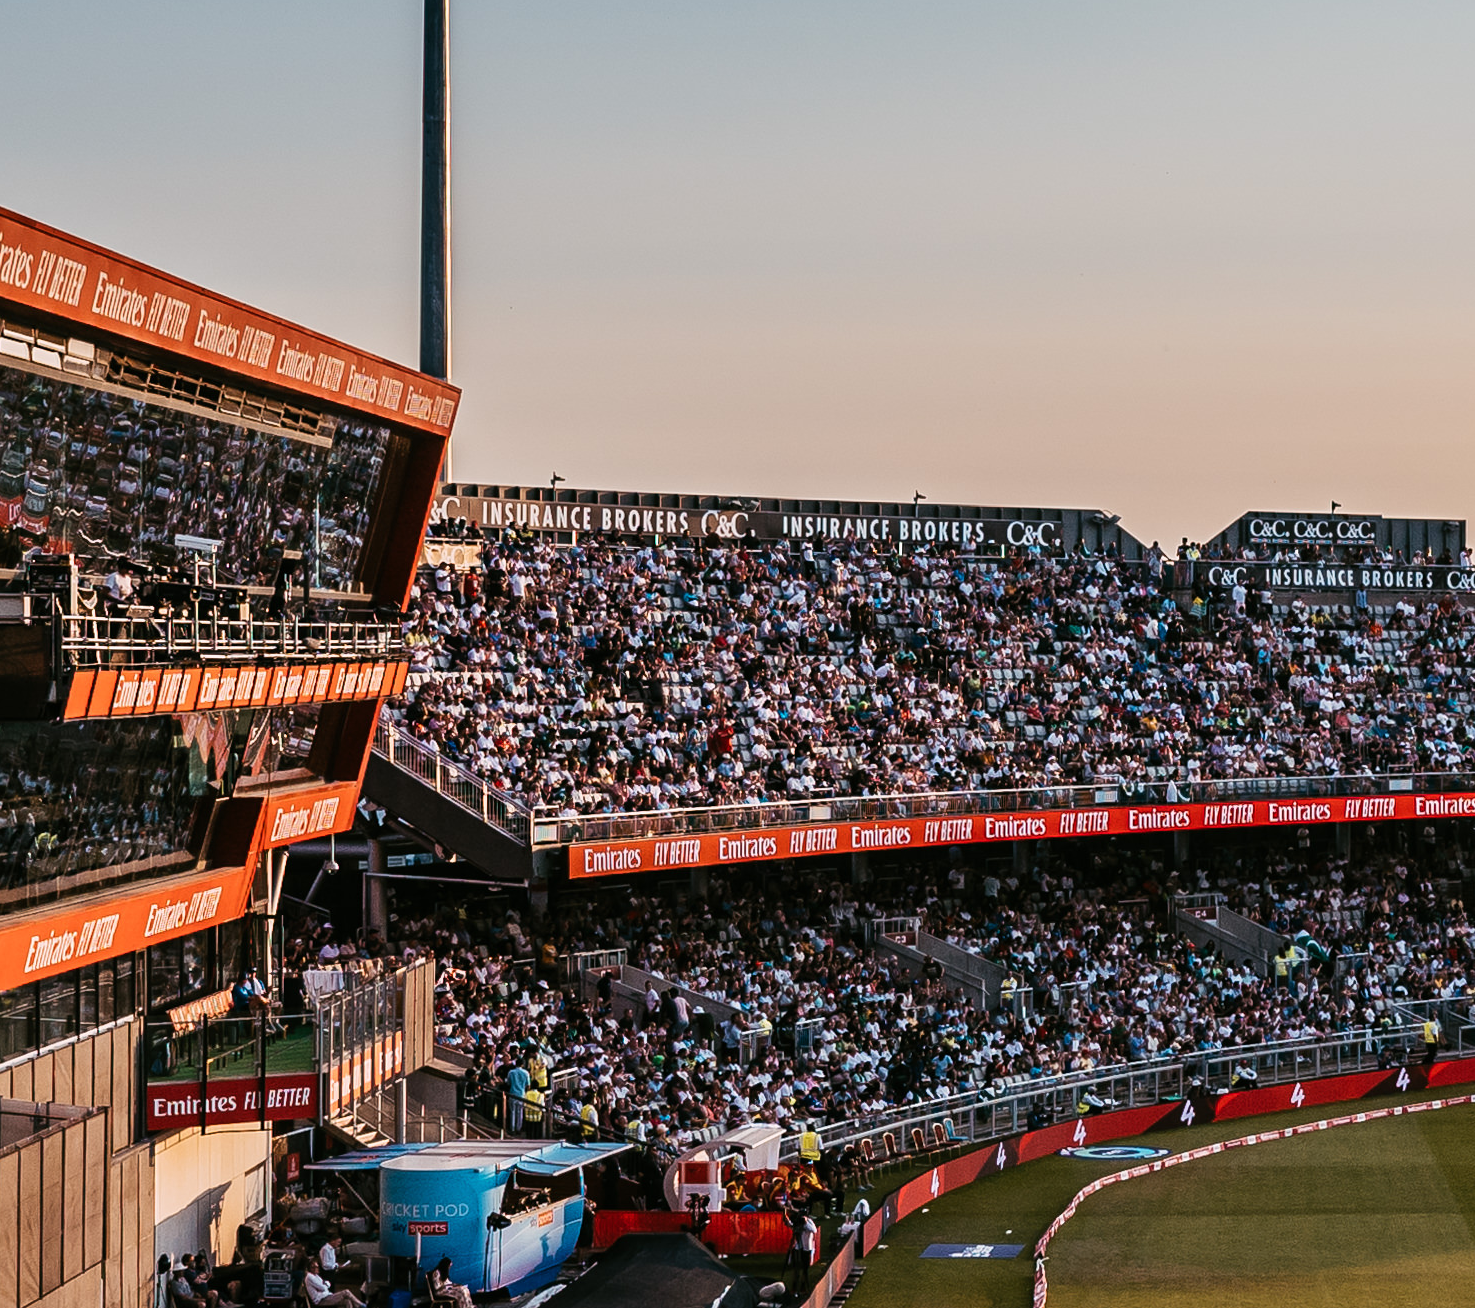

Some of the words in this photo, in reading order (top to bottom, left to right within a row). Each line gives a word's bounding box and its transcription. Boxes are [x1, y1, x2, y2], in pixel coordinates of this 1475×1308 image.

[31, 250, 55, 296] FLY
[48, 256, 87, 307] BETTER
[92, 271, 147, 328] Emirates
[146, 292, 166, 333] FLY
[159, 297, 191, 341] BETTER
[194, 309, 240, 358] Emirates
[276, 339, 316, 383] Emirates
[482, 501, 591, 530] INSURANCE
[601, 508, 689, 534] BROKERS
[1249, 518, 1290, 539] C&C.
[1293, 519, 1333, 539] C&C.
[1336, 521, 1376, 540] C&C.
[899, 520, 985, 543] BROKERS
[1006, 520, 1062, 547] C&C.
[1265, 567, 1355, 588] INSURANCE
[1361, 568, 1435, 589] BROKERS
[584, 846, 641, 873] Emirates
[654, 841, 671, 866] FLY
[670, 839, 701, 865] BETTER
[719, 834, 777, 860] Emirates
[789, 829, 806, 854] FLY
[806, 827, 838, 853] BETTER
[851, 824, 911, 848] Emirates
[924, 820, 941, 843] FLY
[941, 818, 973, 842] BETTER
[985, 815, 1046, 839] Emirates
[1059, 813, 1077, 834] FLY
[1076, 811, 1109, 833] BETTER
[1129, 808, 1190, 830] Emirates
[1204, 805, 1222, 826] FLY
[1221, 803, 1254, 825] BETTER
[1268, 801, 1331, 822] Emirates
[1345, 799, 1363, 818] FLY
[1362, 797, 1396, 817] BETTER
[144, 900, 189, 938] Emirates
[24, 930, 78, 974] Emirates
[88, 913, 120, 954] BETTER
[1396, 1067, 1410, 1092] 4
[244, 1091, 261, 1111] FL
[267, 1087, 311, 1108] BETTER
[1290, 1082, 1305, 1108] 4
[1180, 1099, 1196, 1126] 4
[1073, 1118, 1087, 1146] 4
[382, 1202, 430, 1218] CRICKET
[435, 1203, 470, 1218] POD
[392, 1222, 407, 1234] sky
[409, 1222, 447, 1234] sports
